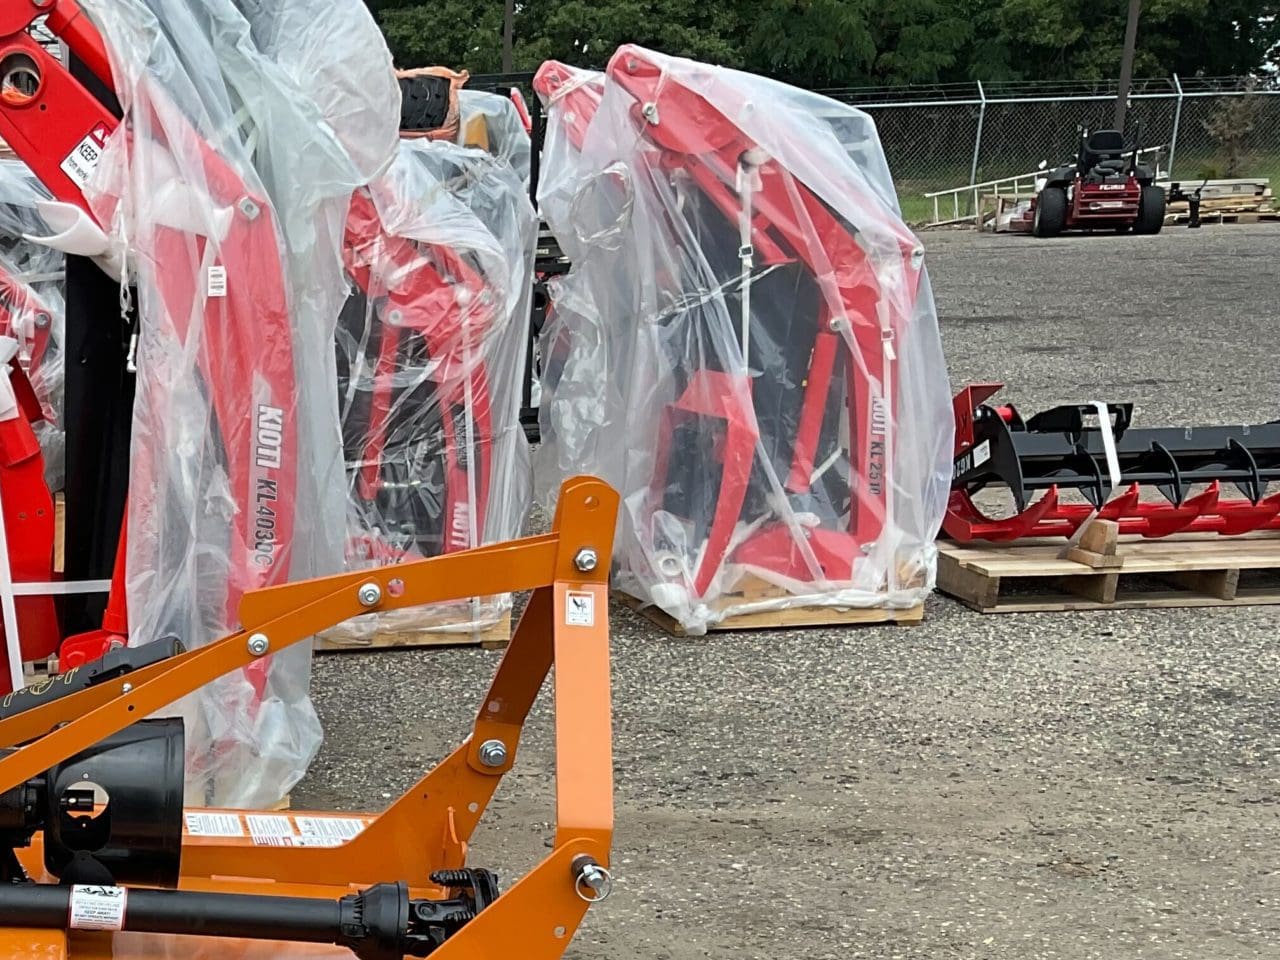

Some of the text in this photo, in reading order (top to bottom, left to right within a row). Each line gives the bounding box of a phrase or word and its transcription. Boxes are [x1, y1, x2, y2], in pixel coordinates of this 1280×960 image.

[78, 141, 98, 162] KEEP
[254, 404, 283, 569] KIOTI KL4030C
